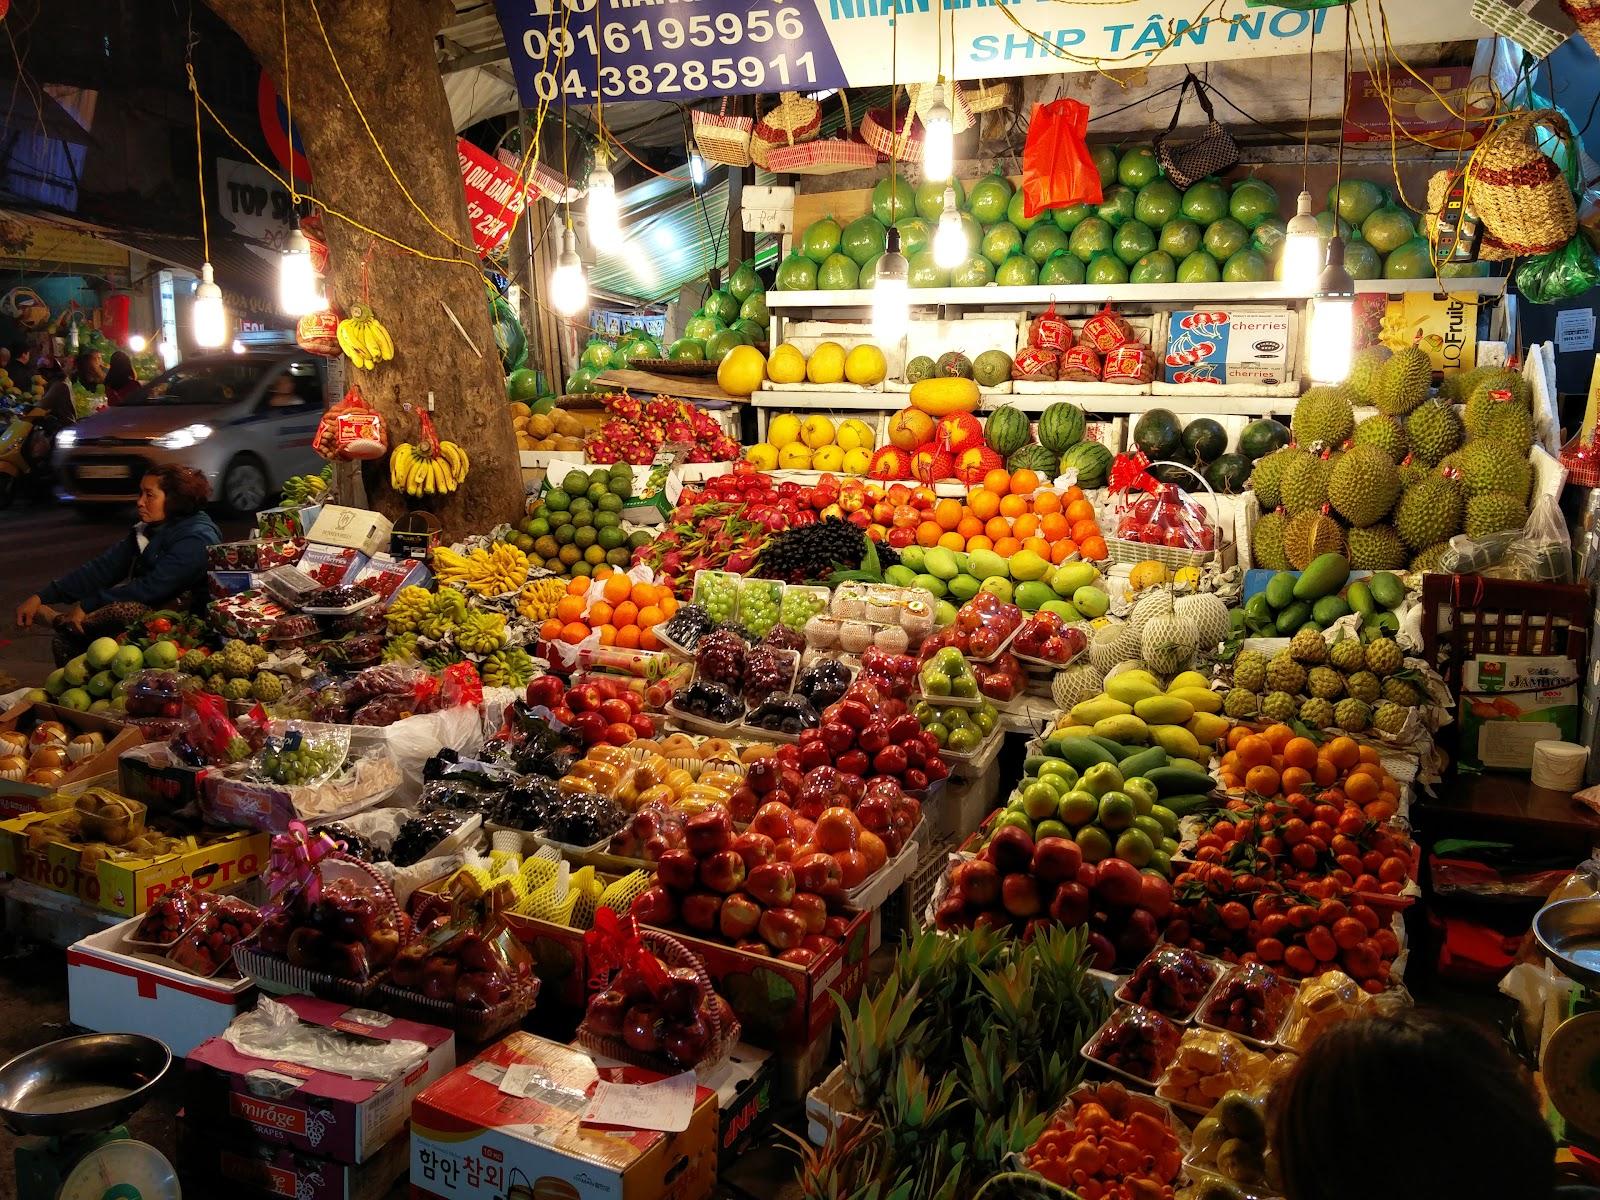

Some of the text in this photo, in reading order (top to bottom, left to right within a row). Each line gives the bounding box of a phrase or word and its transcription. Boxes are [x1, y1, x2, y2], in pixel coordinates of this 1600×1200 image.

[522, 7, 804, 60] 0916195956
[970, 28, 1086, 63] SHIP
[1103, 14, 1210, 57] TẬN
[533, 51, 817, 101] 04.38285911
[227, 181, 269, 217] TOP
[475, 214, 508, 239] 25K
[1231, 321, 1287, 331] cherries
[1228, 369, 1274, 378] cherries
[419, 1148, 460, 1190] 함안
[462, 1155, 504, 1192] 참외
